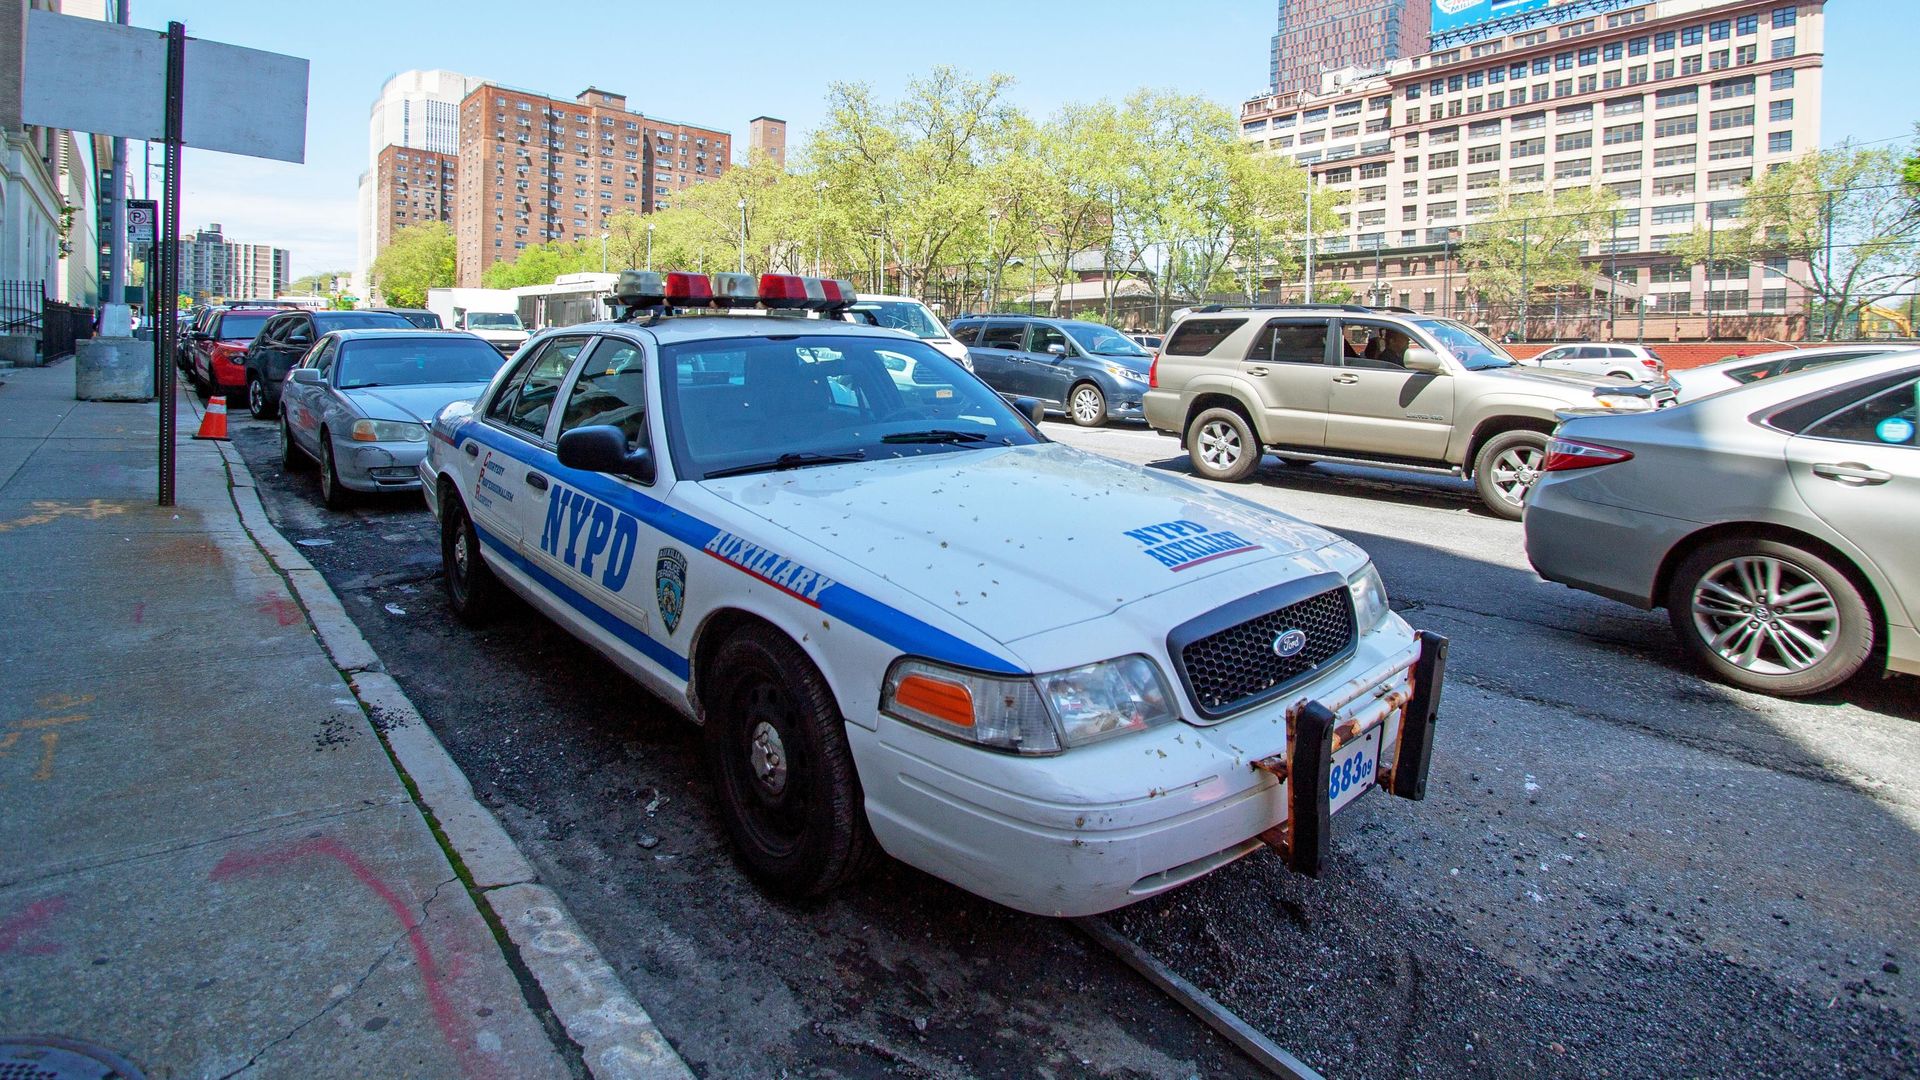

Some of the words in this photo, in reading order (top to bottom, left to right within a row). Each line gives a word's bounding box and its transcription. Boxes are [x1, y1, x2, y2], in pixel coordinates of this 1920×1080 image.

[540, 483, 638, 592] NYPD
[1123, 520, 1208, 546] NYPD
[1143, 531, 1253, 567] AUXILIARY
[704, 530, 838, 601] AUXILIARY
